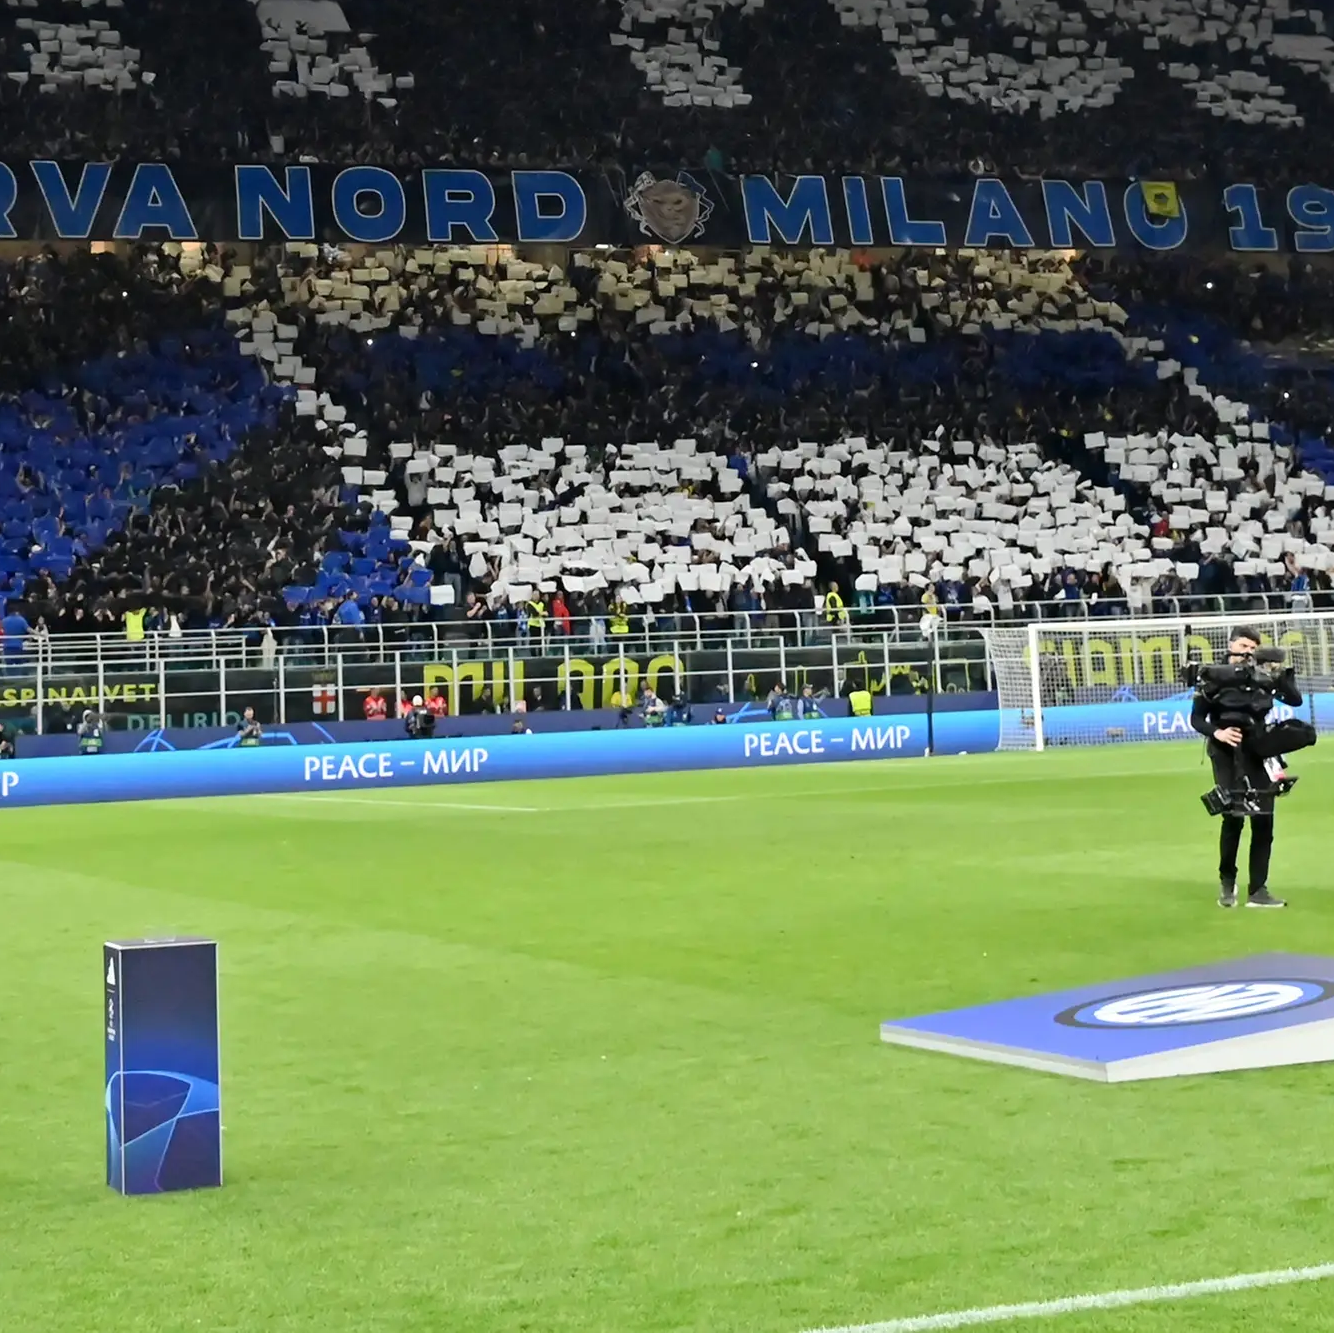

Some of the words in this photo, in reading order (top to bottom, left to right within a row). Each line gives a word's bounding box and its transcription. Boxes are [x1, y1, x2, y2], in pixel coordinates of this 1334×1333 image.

[234, 164, 588, 243] NORD
[740, 173, 1188, 250] MILANO
[1143, 711, 1212, 735] PEA
[744, 729, 824, 757] PEACE
[851, 724, 911, 752] МИР
[304, 752, 394, 780] PEACE
[422, 748, 488, 776] МИР
